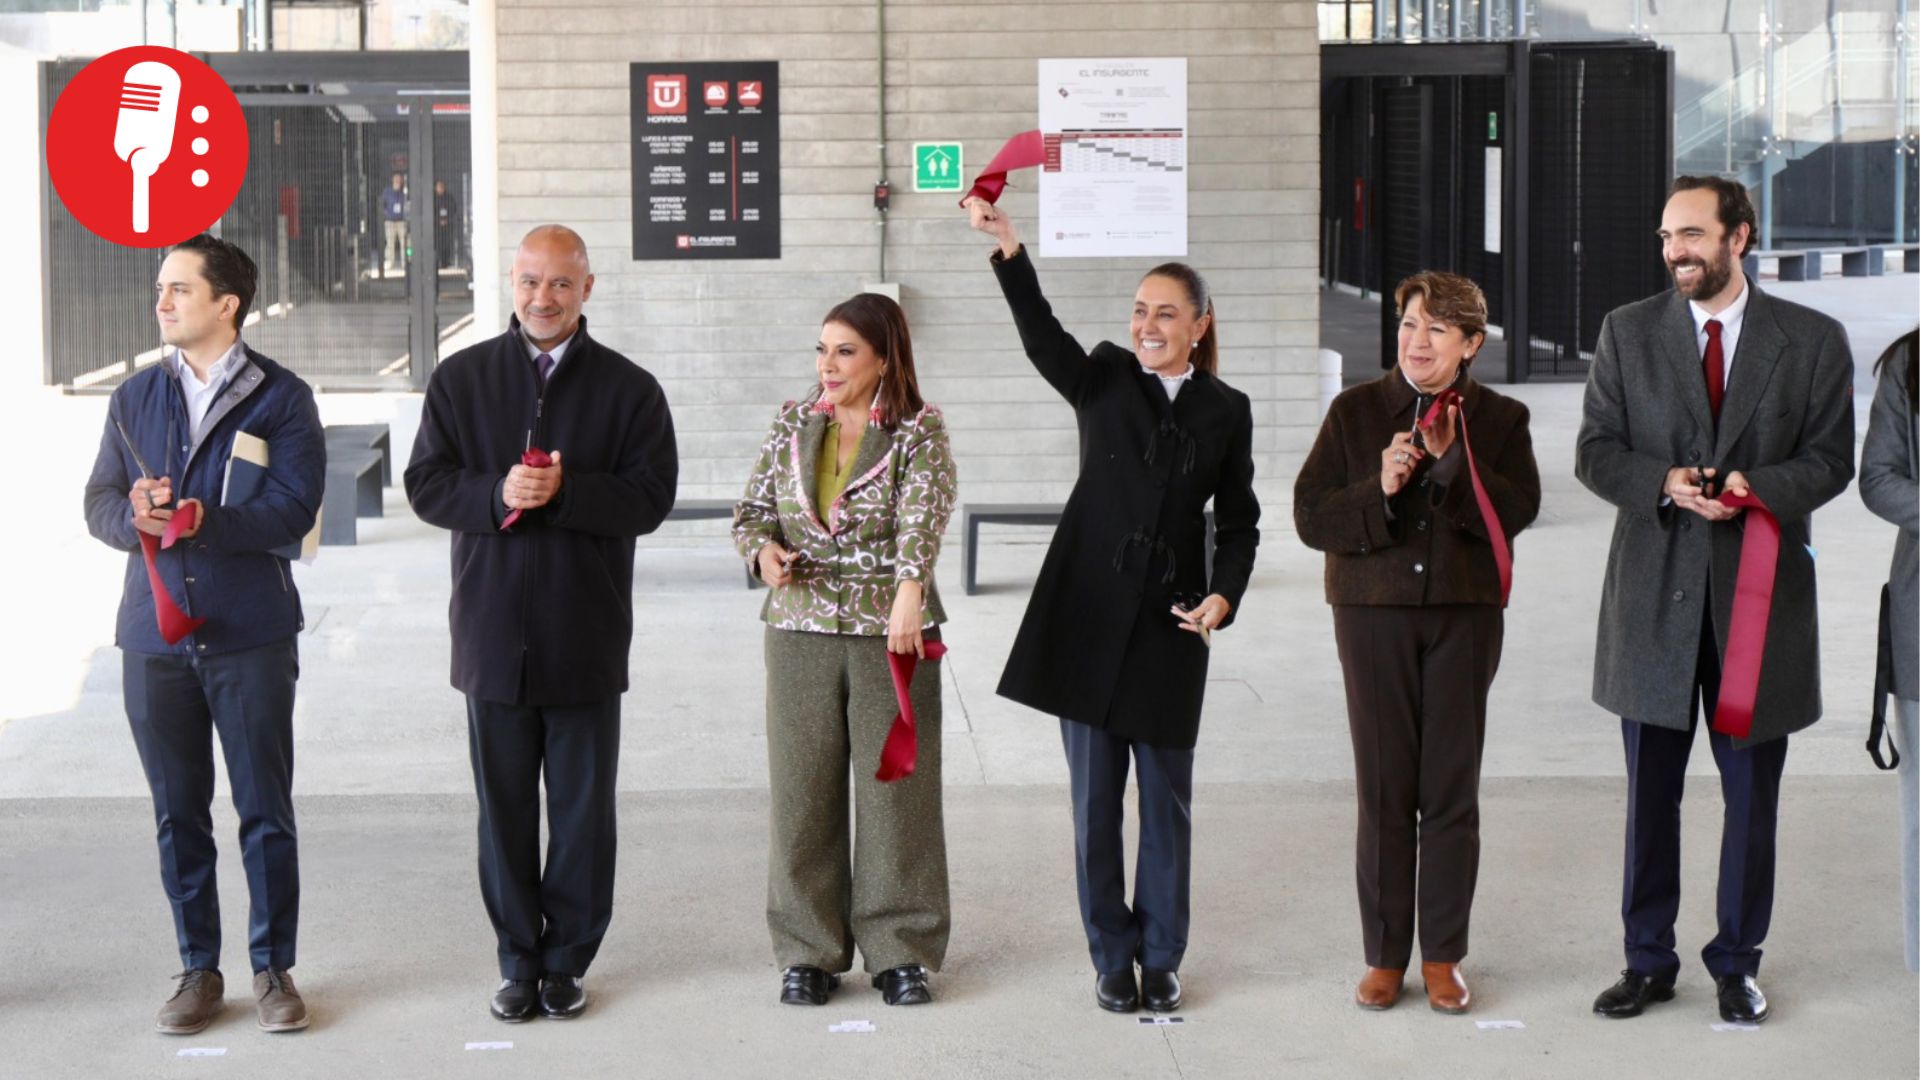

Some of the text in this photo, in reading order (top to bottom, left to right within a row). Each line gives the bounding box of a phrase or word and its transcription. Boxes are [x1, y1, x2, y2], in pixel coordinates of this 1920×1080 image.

[1079, 68, 1150, 78] EL INSURGENTE
[646, 115, 688, 124] HORARIOS
